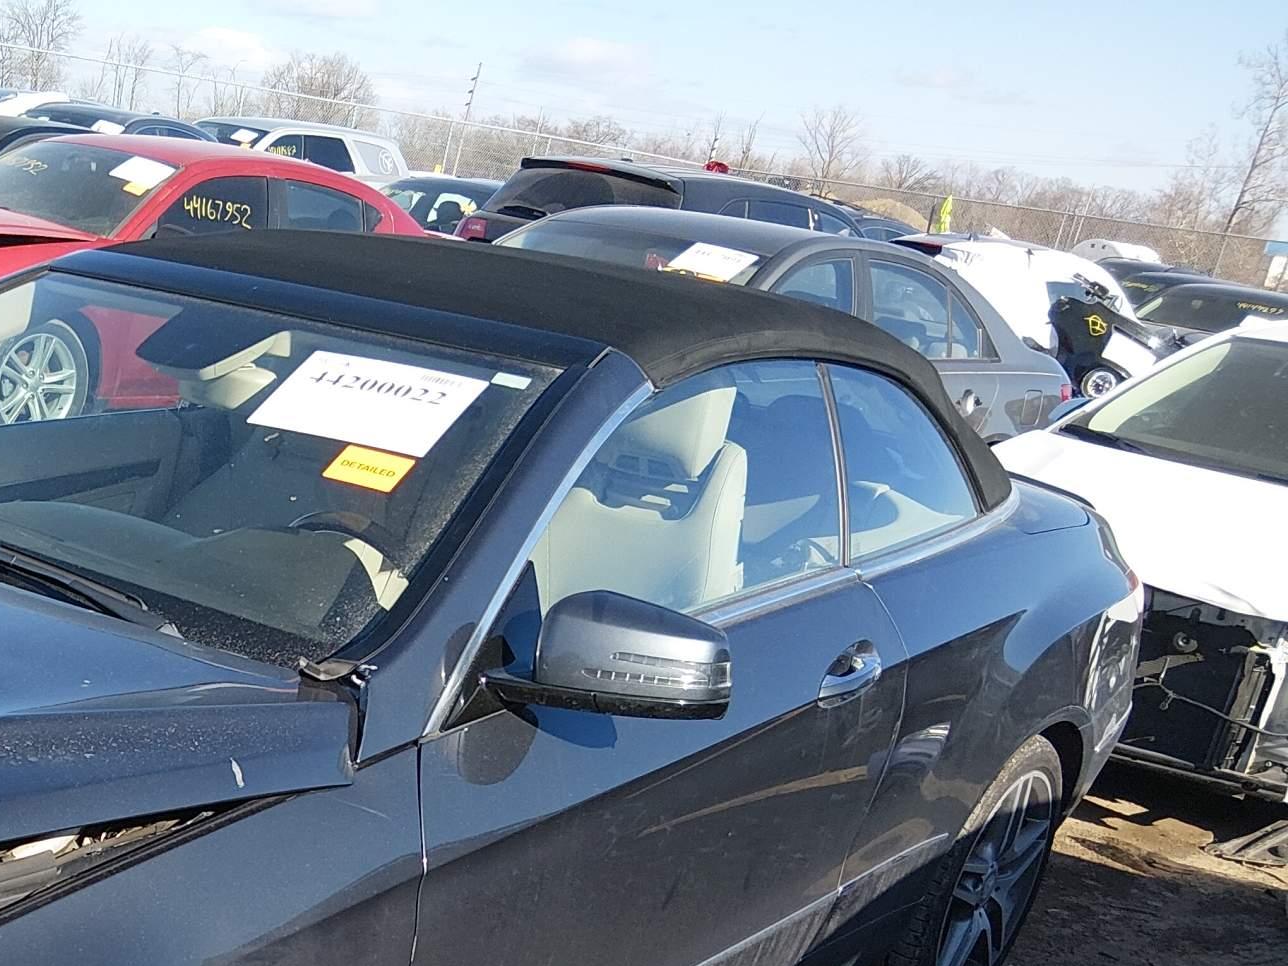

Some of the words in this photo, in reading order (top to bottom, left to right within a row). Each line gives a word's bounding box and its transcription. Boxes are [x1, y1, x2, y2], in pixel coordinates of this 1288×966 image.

[183, 195, 252, 230] 44167952
[310, 371, 448, 405] 44200022
[340, 459, 396, 478] DETAILED
